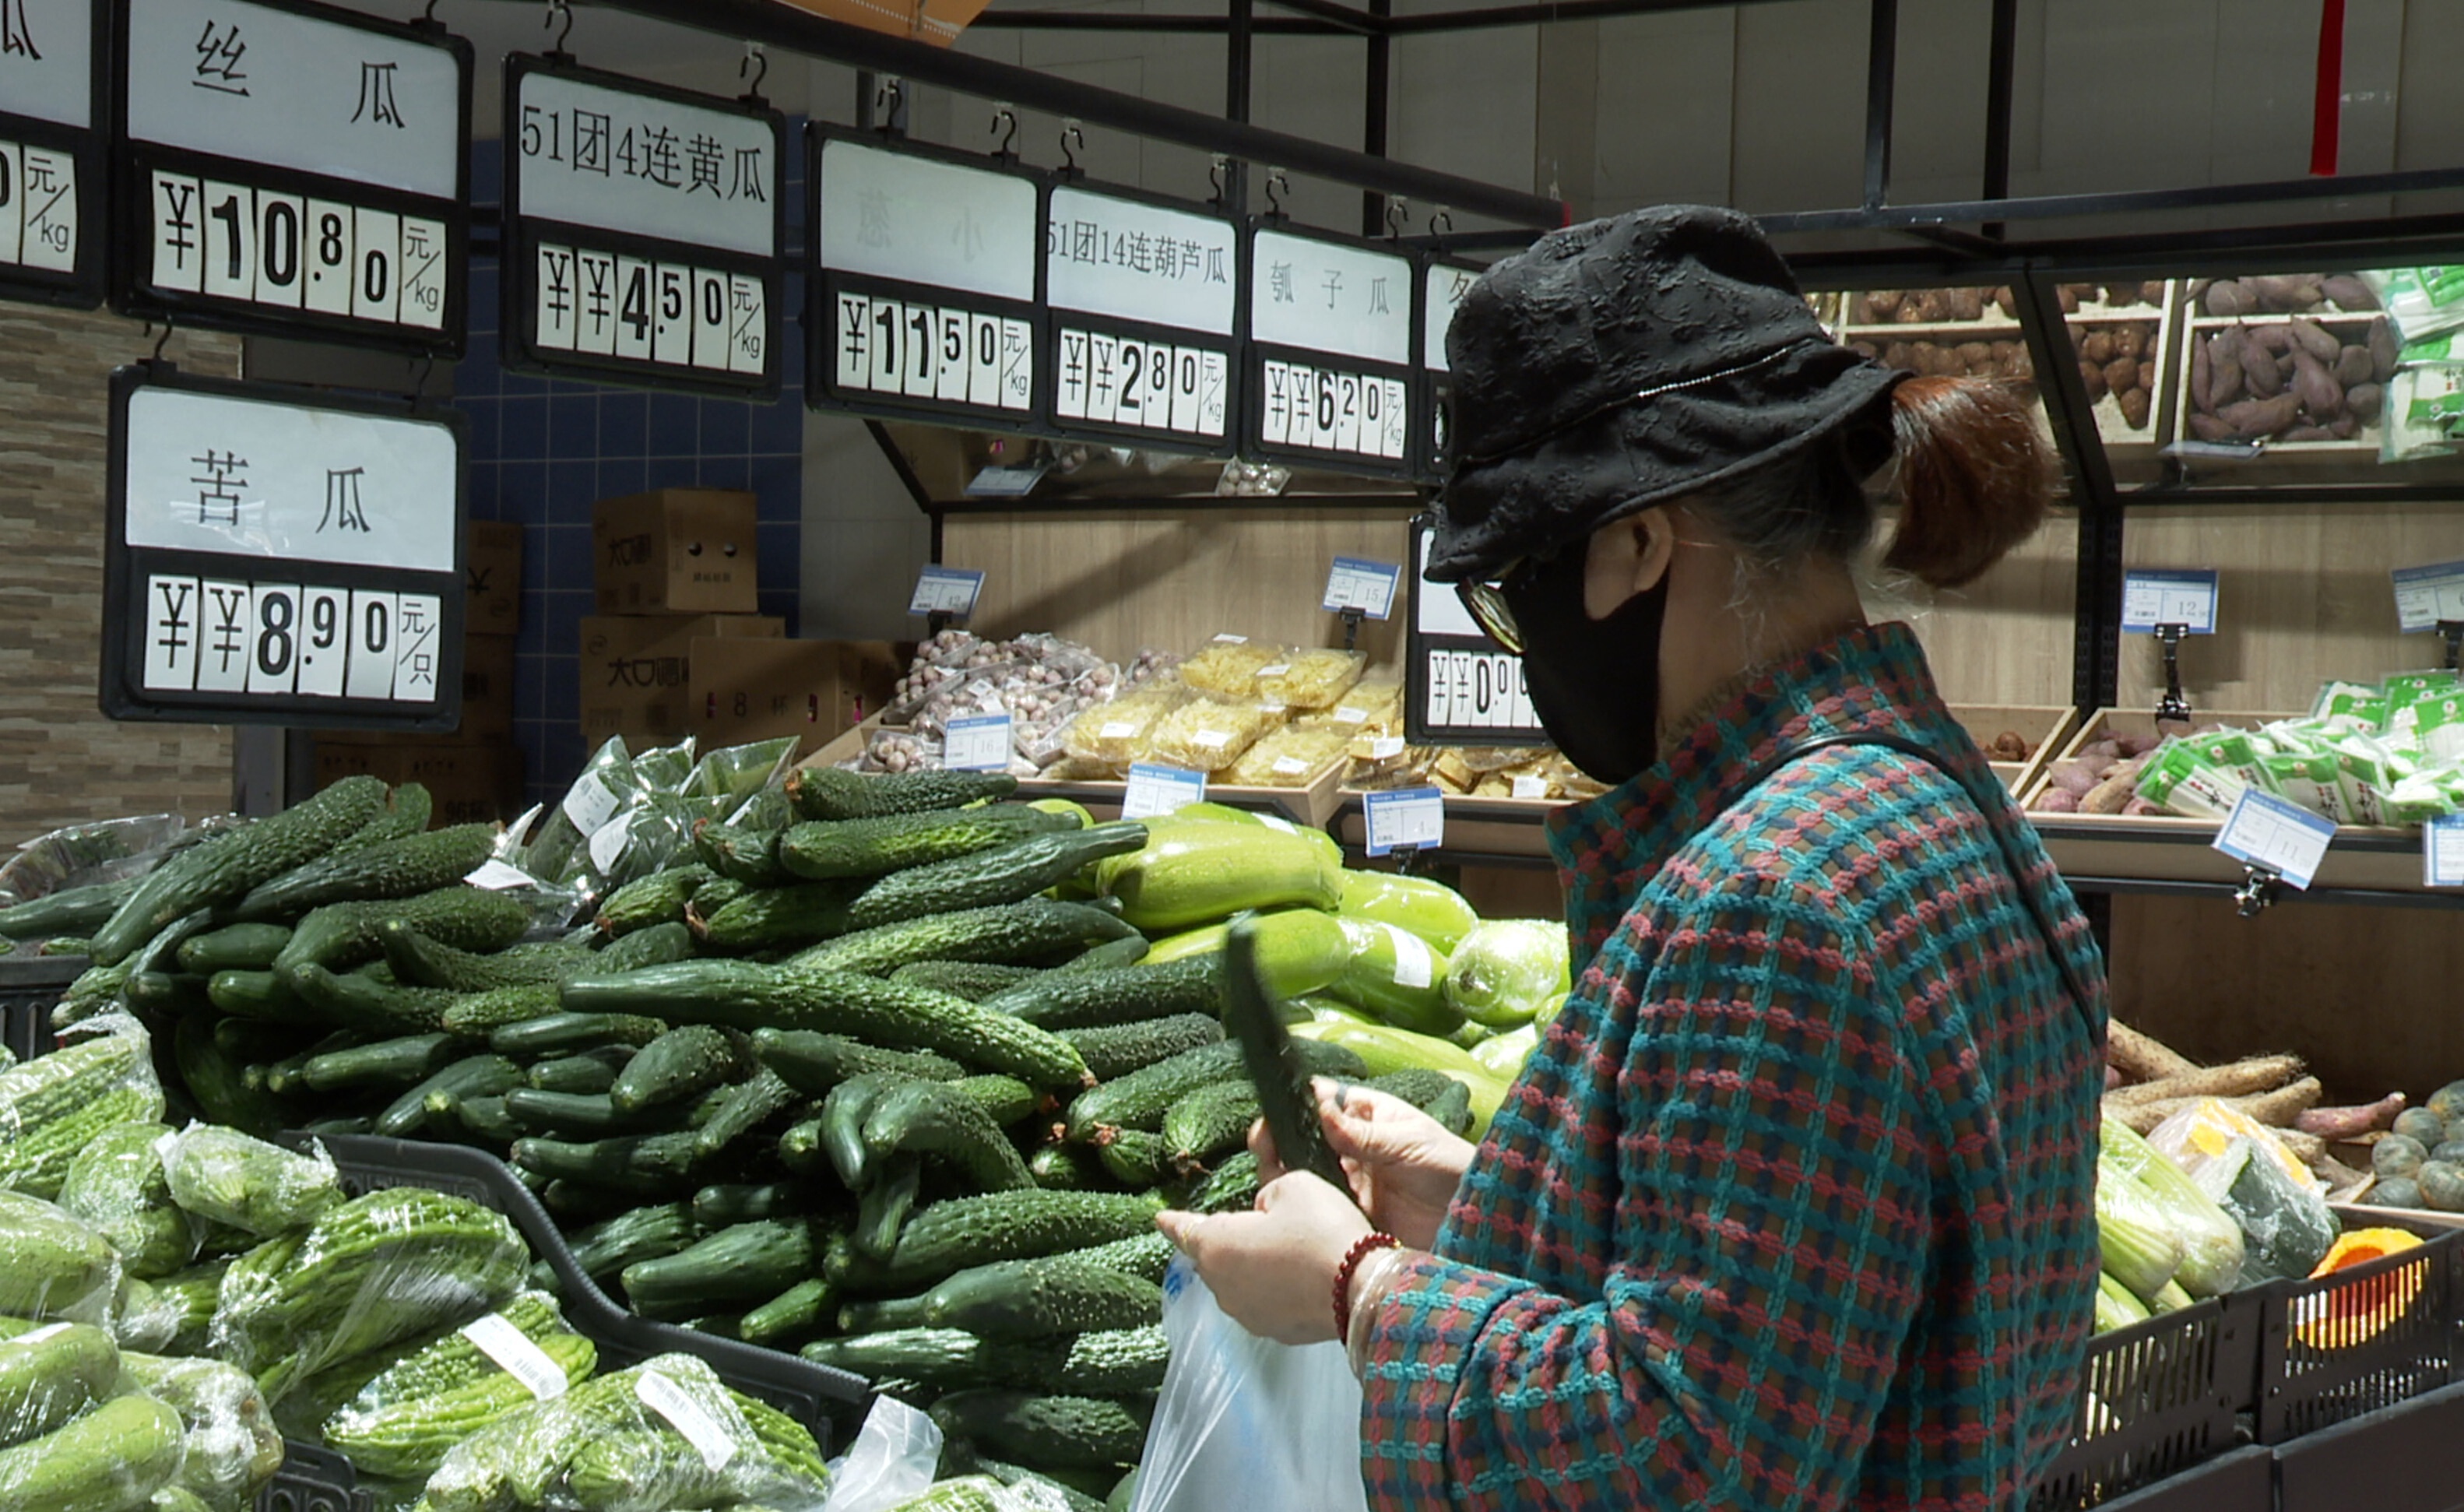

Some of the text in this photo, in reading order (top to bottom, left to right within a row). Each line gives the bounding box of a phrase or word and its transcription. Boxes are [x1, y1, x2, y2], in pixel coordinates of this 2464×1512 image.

[521, 104, 767, 202] 51团4连黄瓜
[1048, 220, 1228, 285] 51团14连葫芦瓜
